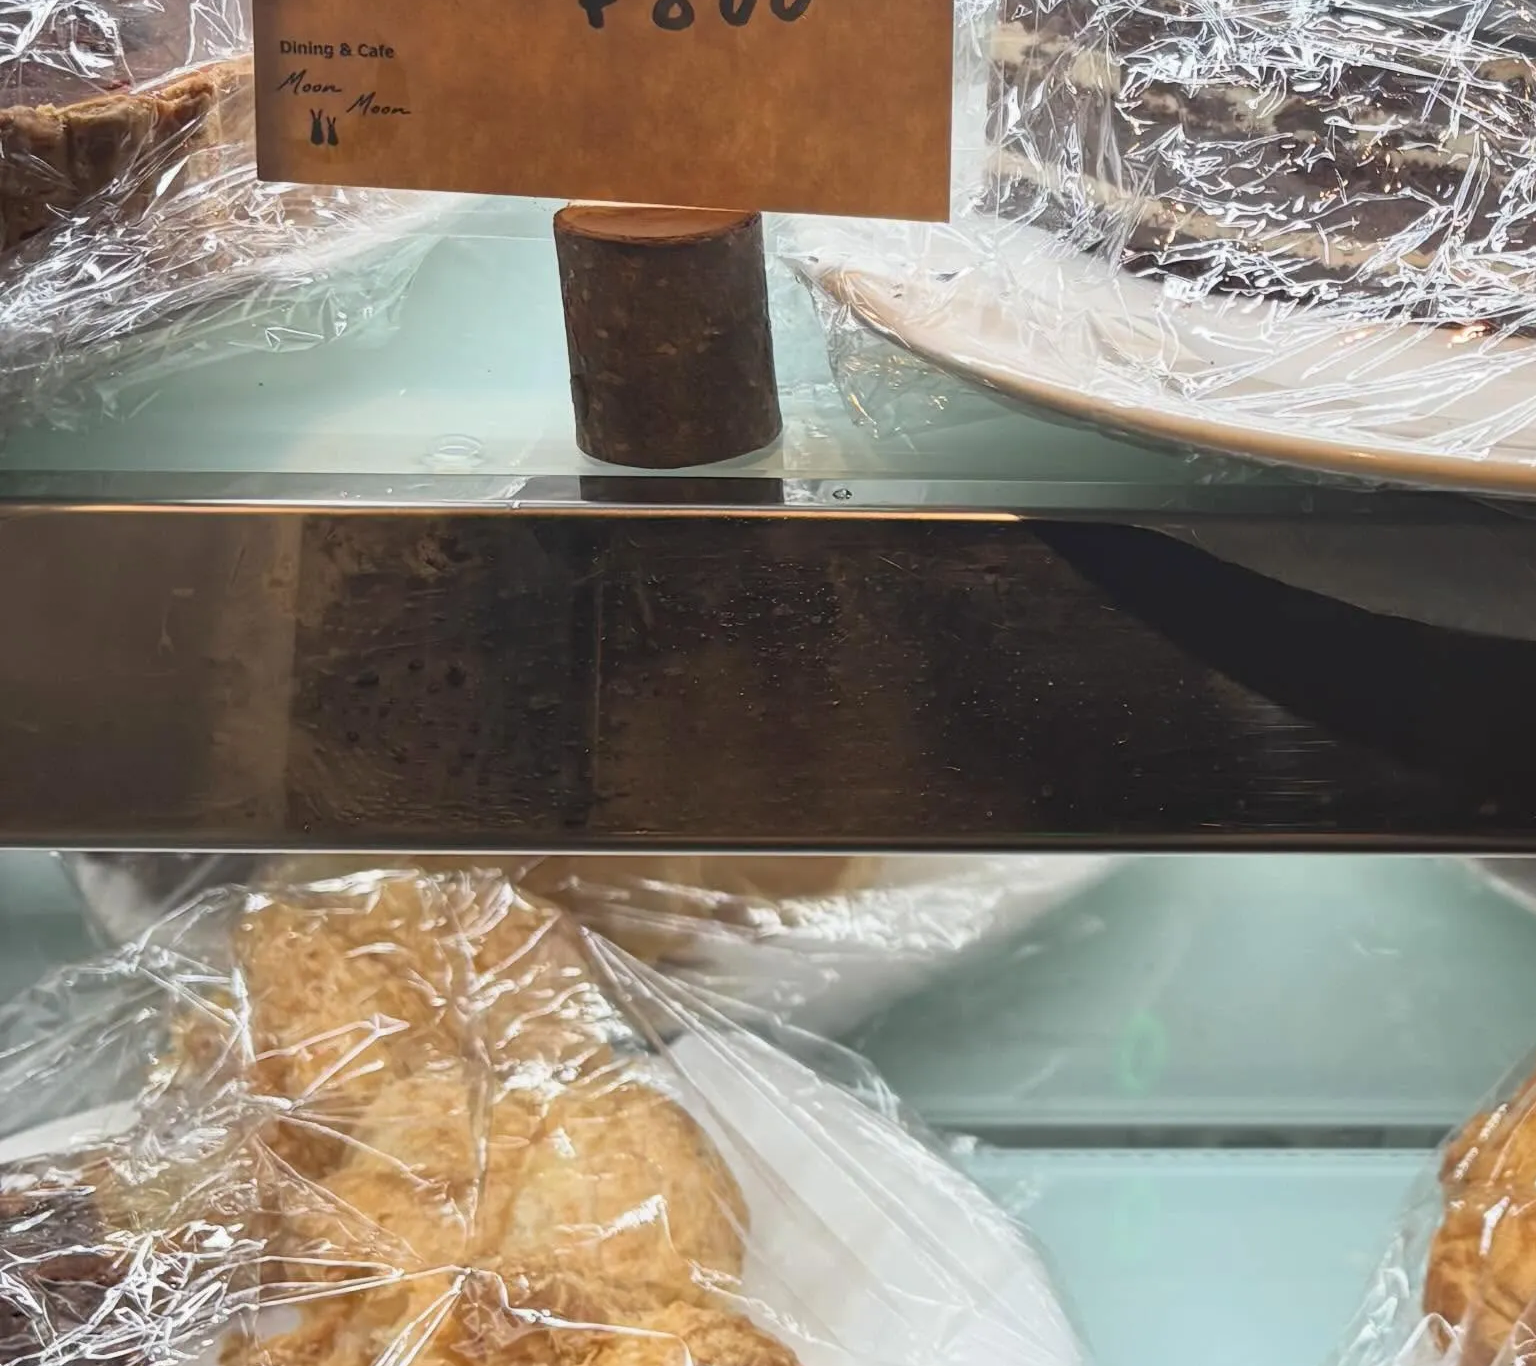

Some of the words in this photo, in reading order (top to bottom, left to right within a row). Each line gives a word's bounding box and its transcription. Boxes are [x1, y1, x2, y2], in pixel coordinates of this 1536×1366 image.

[279, 40, 334, 59] Dining
[340, 42, 352, 57] &
[357, 44, 395, 59] Cafe
[276, 69, 342, 95] Moon
[346, 92, 411, 116] Moon
